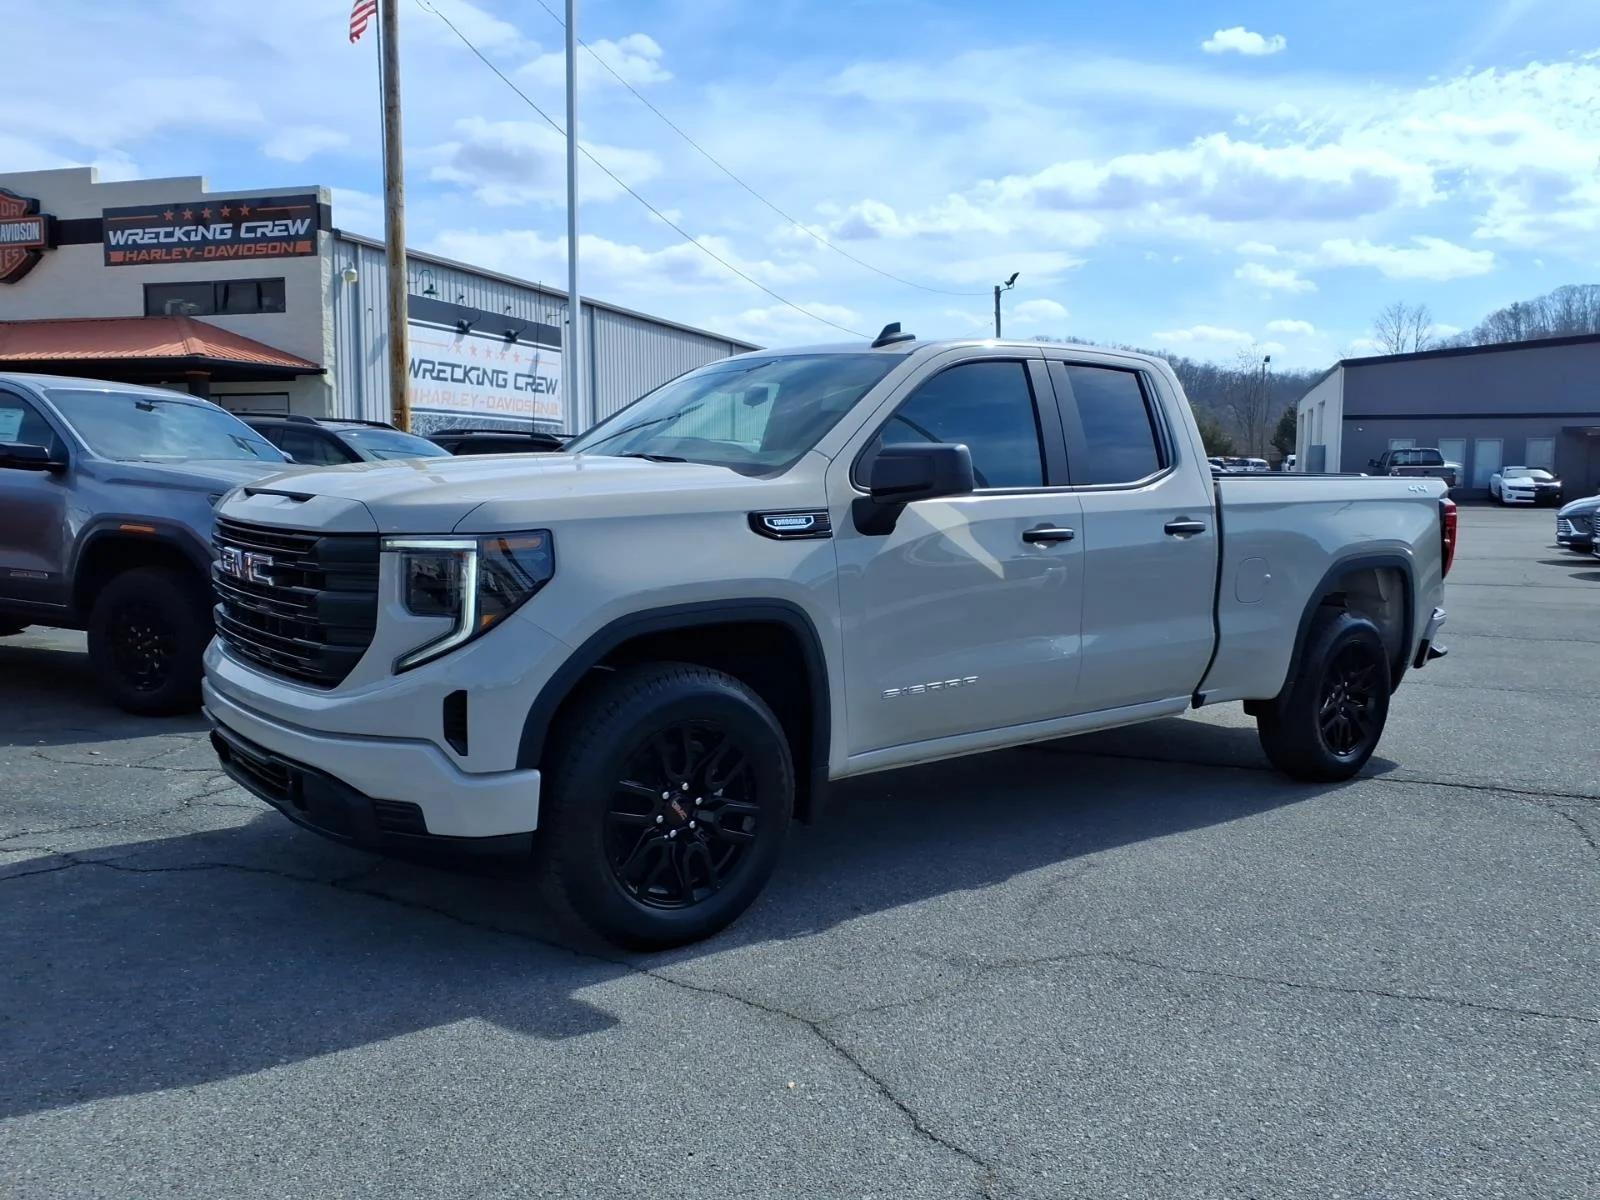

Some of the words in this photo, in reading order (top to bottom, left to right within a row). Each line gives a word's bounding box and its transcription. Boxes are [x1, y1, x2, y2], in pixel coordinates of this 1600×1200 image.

[108, 223, 233, 246] WRECKING
[240, 218, 311, 238] CREW
[125, 241, 294, 262] HARLEY-DAVIDSON
[514, 372, 558, 395] CREW
[420, 390, 551, 414] HARLEY-DAVIDSON
[223, 546, 274, 587] GMC
[882, 676, 979, 699] SIERRA
